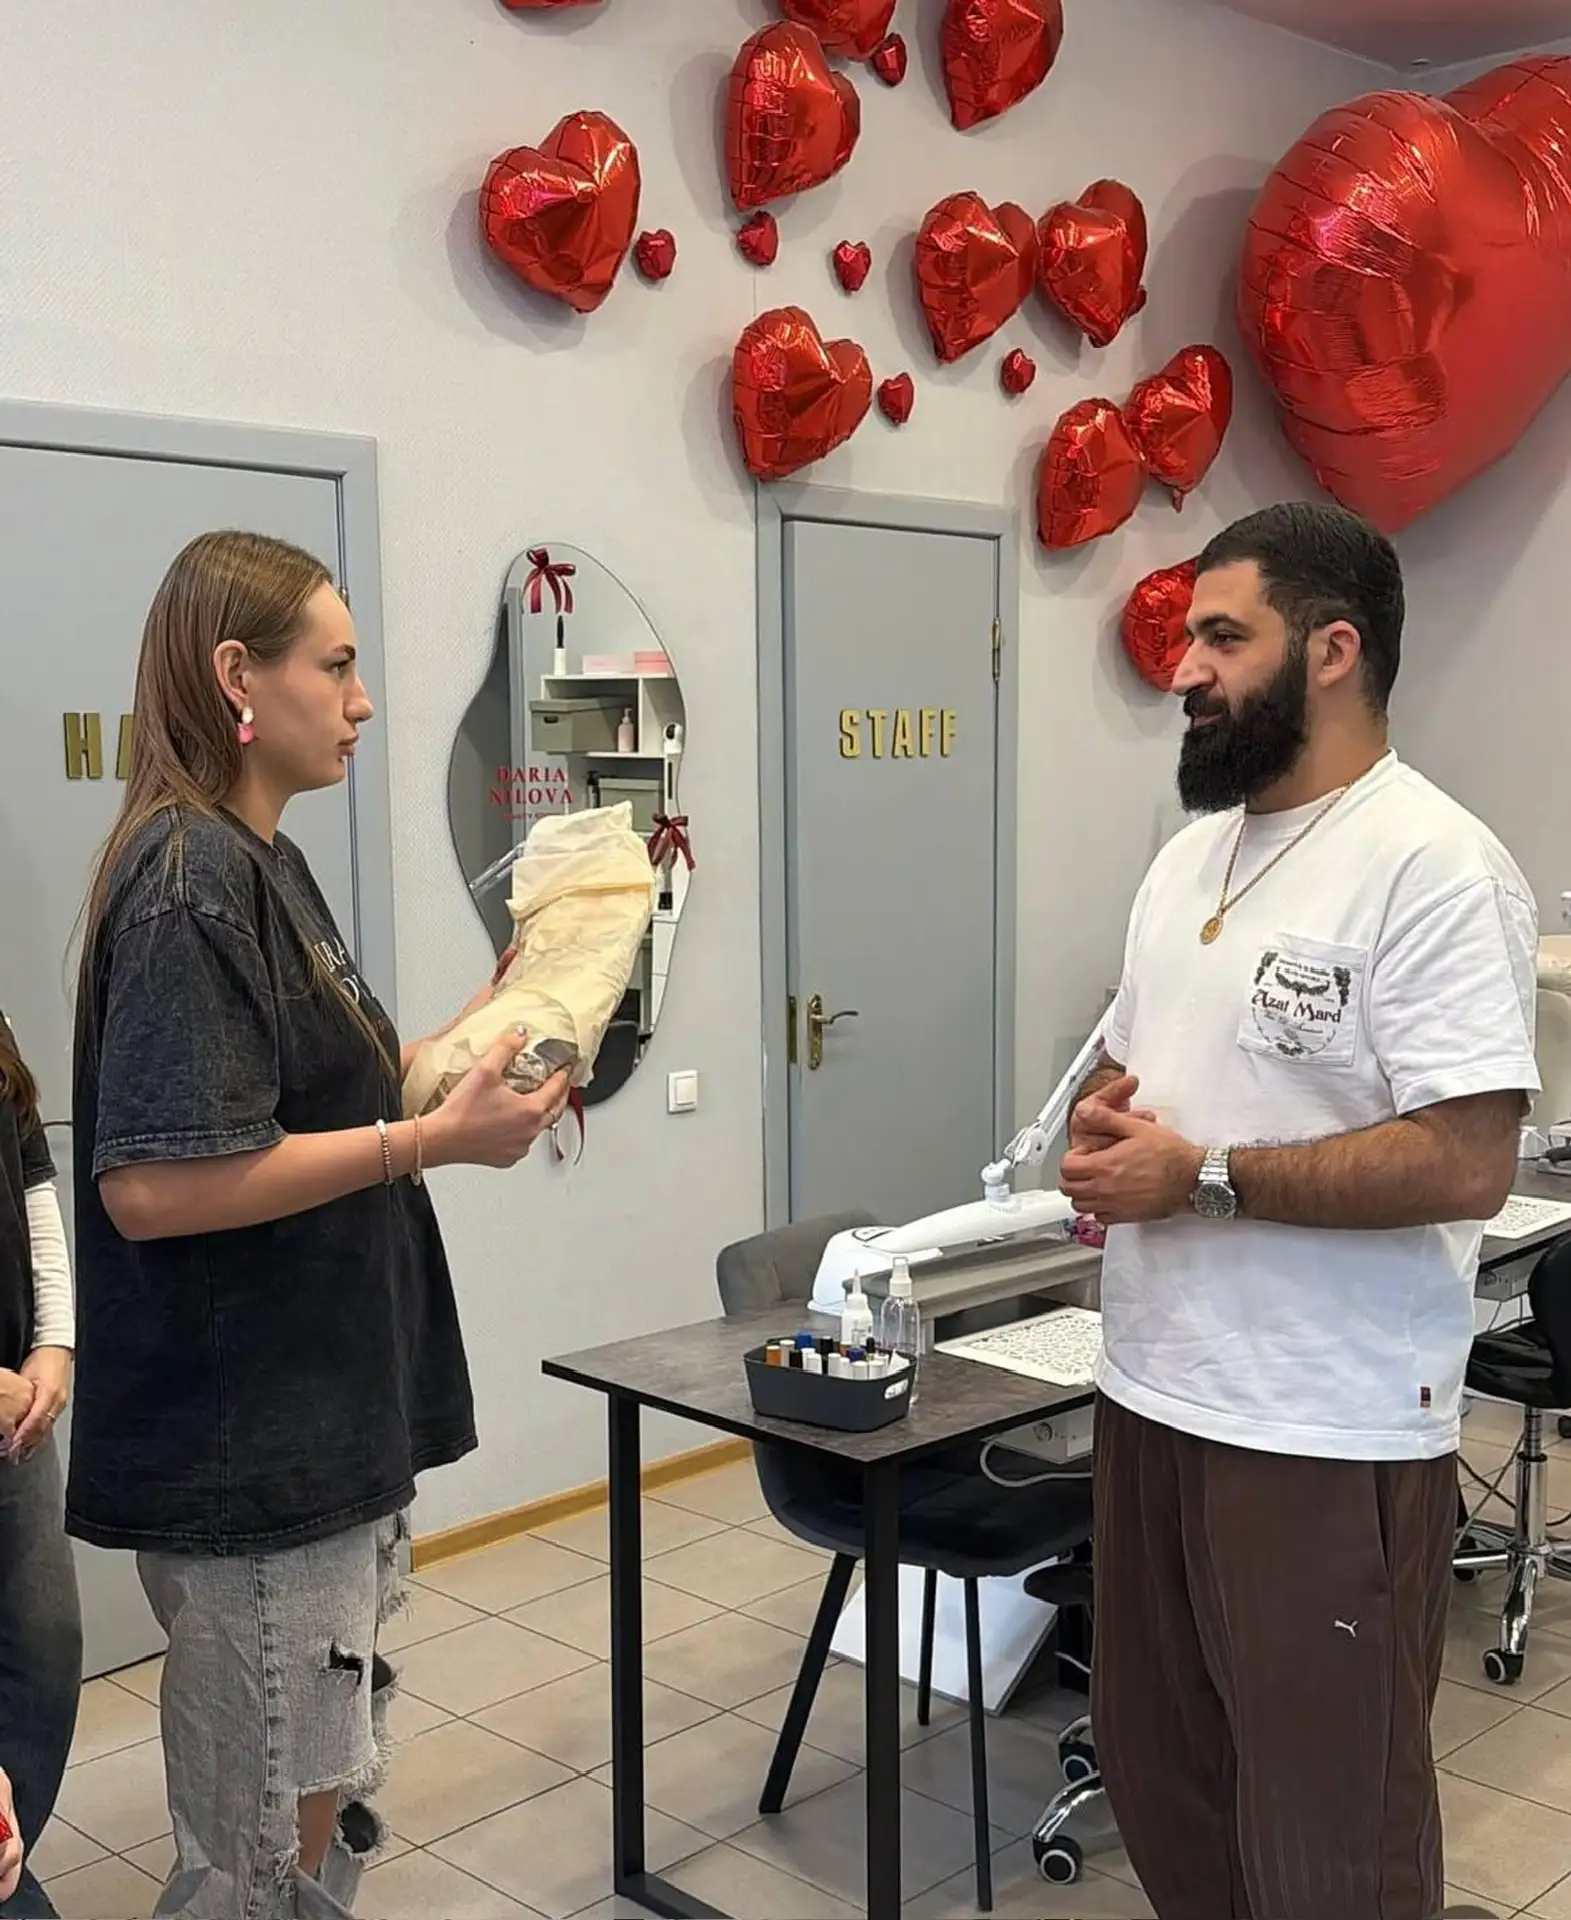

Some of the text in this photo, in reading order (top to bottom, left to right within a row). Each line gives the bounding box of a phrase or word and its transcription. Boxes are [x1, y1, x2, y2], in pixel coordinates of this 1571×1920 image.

[839, 708, 957, 759] STAFF
[497, 767, 565, 783] DARIA
[490, 788, 573, 806] NILOVA
